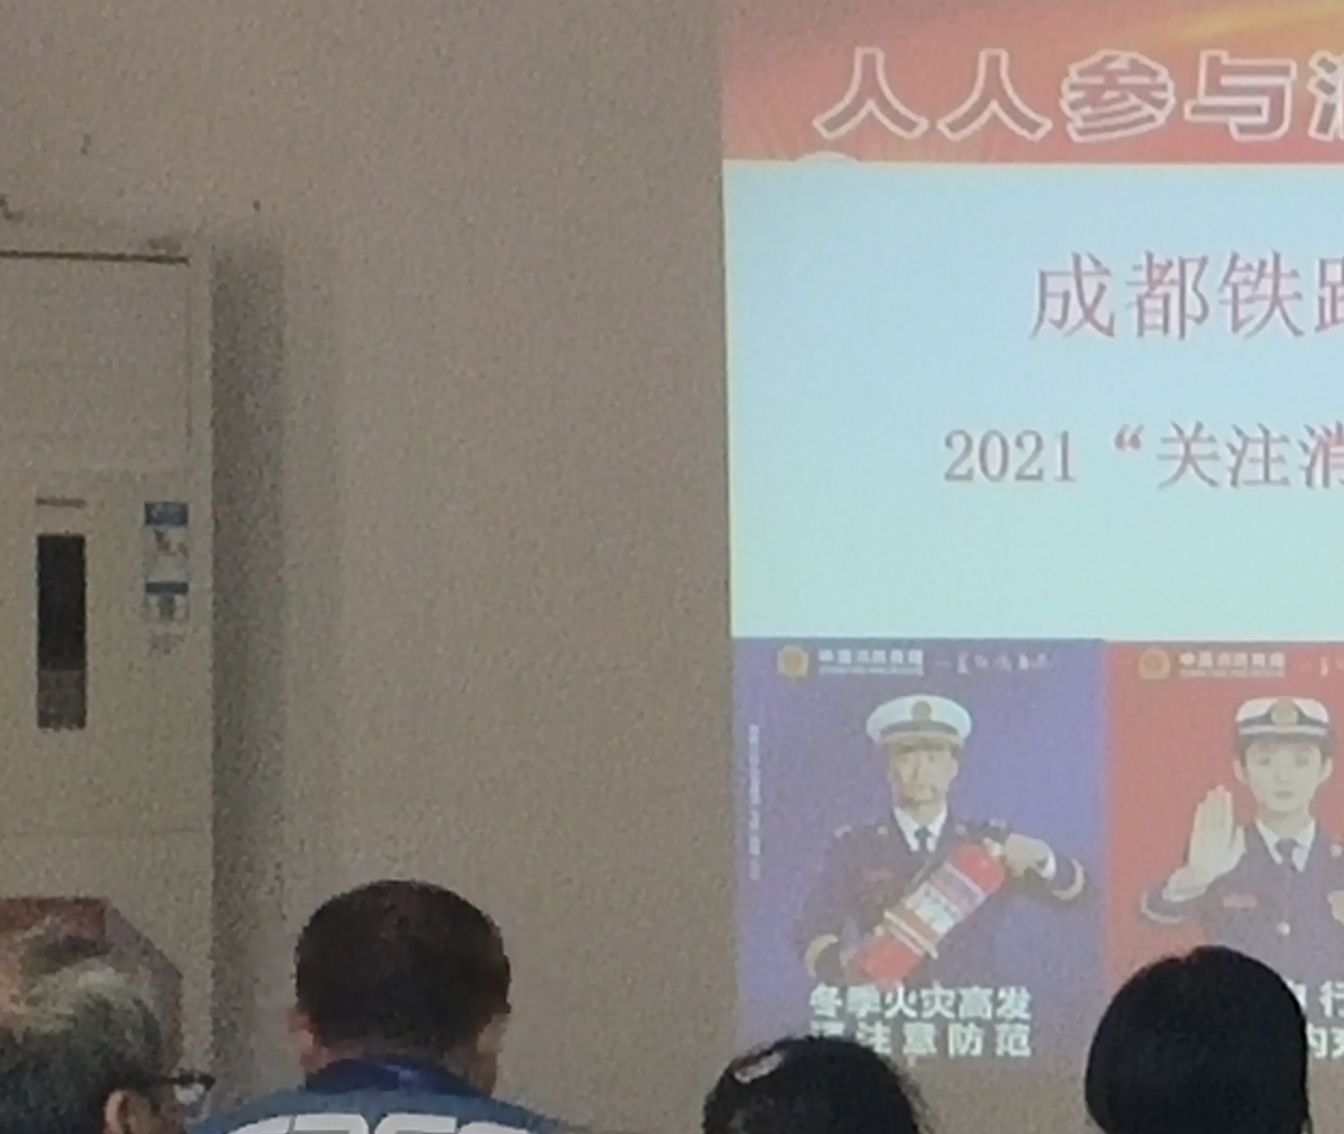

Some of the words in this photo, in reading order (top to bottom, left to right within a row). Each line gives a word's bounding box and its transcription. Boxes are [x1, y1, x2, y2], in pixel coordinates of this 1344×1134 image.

[808, 982, 1033, 1020] 冬季火灾高发
